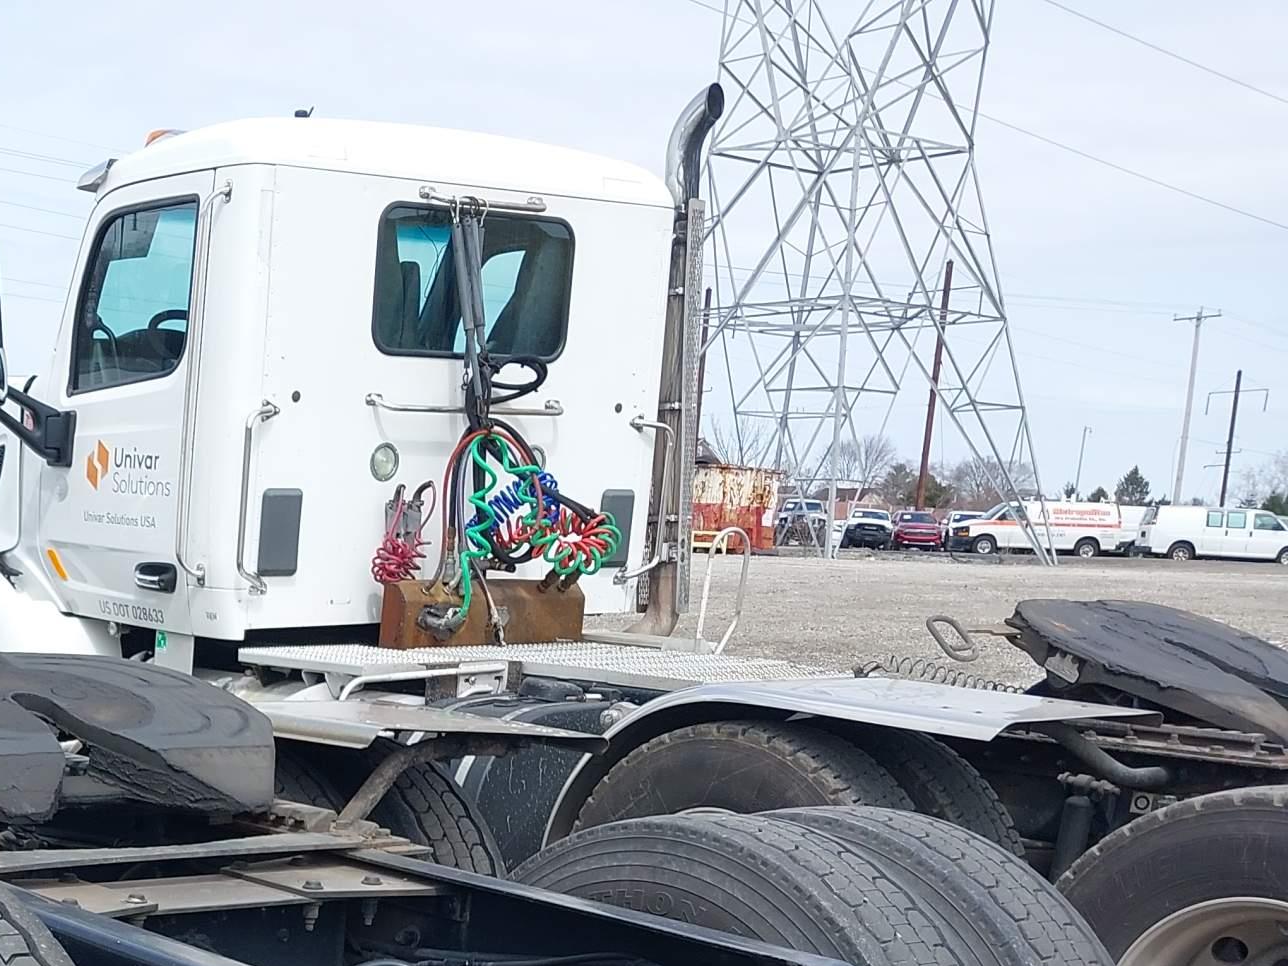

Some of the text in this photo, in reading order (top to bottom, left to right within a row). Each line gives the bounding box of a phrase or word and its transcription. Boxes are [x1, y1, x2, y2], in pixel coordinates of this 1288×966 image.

[114, 446, 160, 470] Univar
[112, 471, 171, 497] Solutions
[83, 510, 157, 528] Univar Solutions USA
[99, 600, 112, 615] US
[132, 606, 165, 624] 028633
